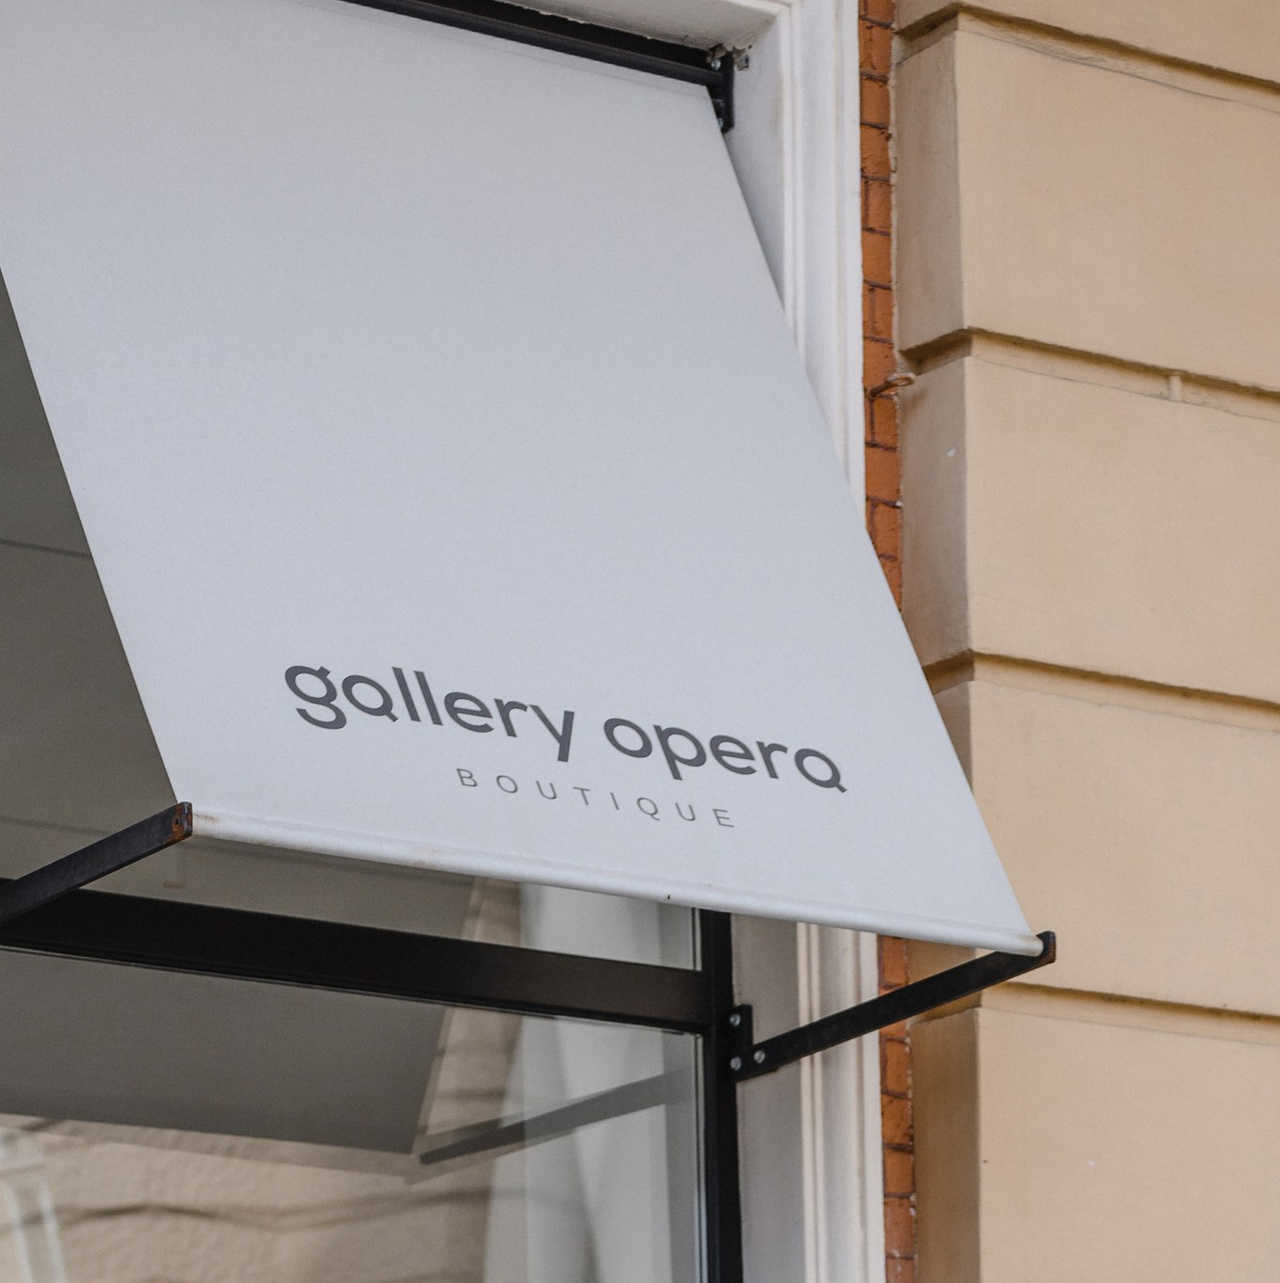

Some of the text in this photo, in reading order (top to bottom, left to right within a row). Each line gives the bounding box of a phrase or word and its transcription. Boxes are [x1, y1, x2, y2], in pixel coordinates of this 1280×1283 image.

[284, 664, 847, 794] gallery opera
[456, 768, 736, 829] BOUTIQUE
